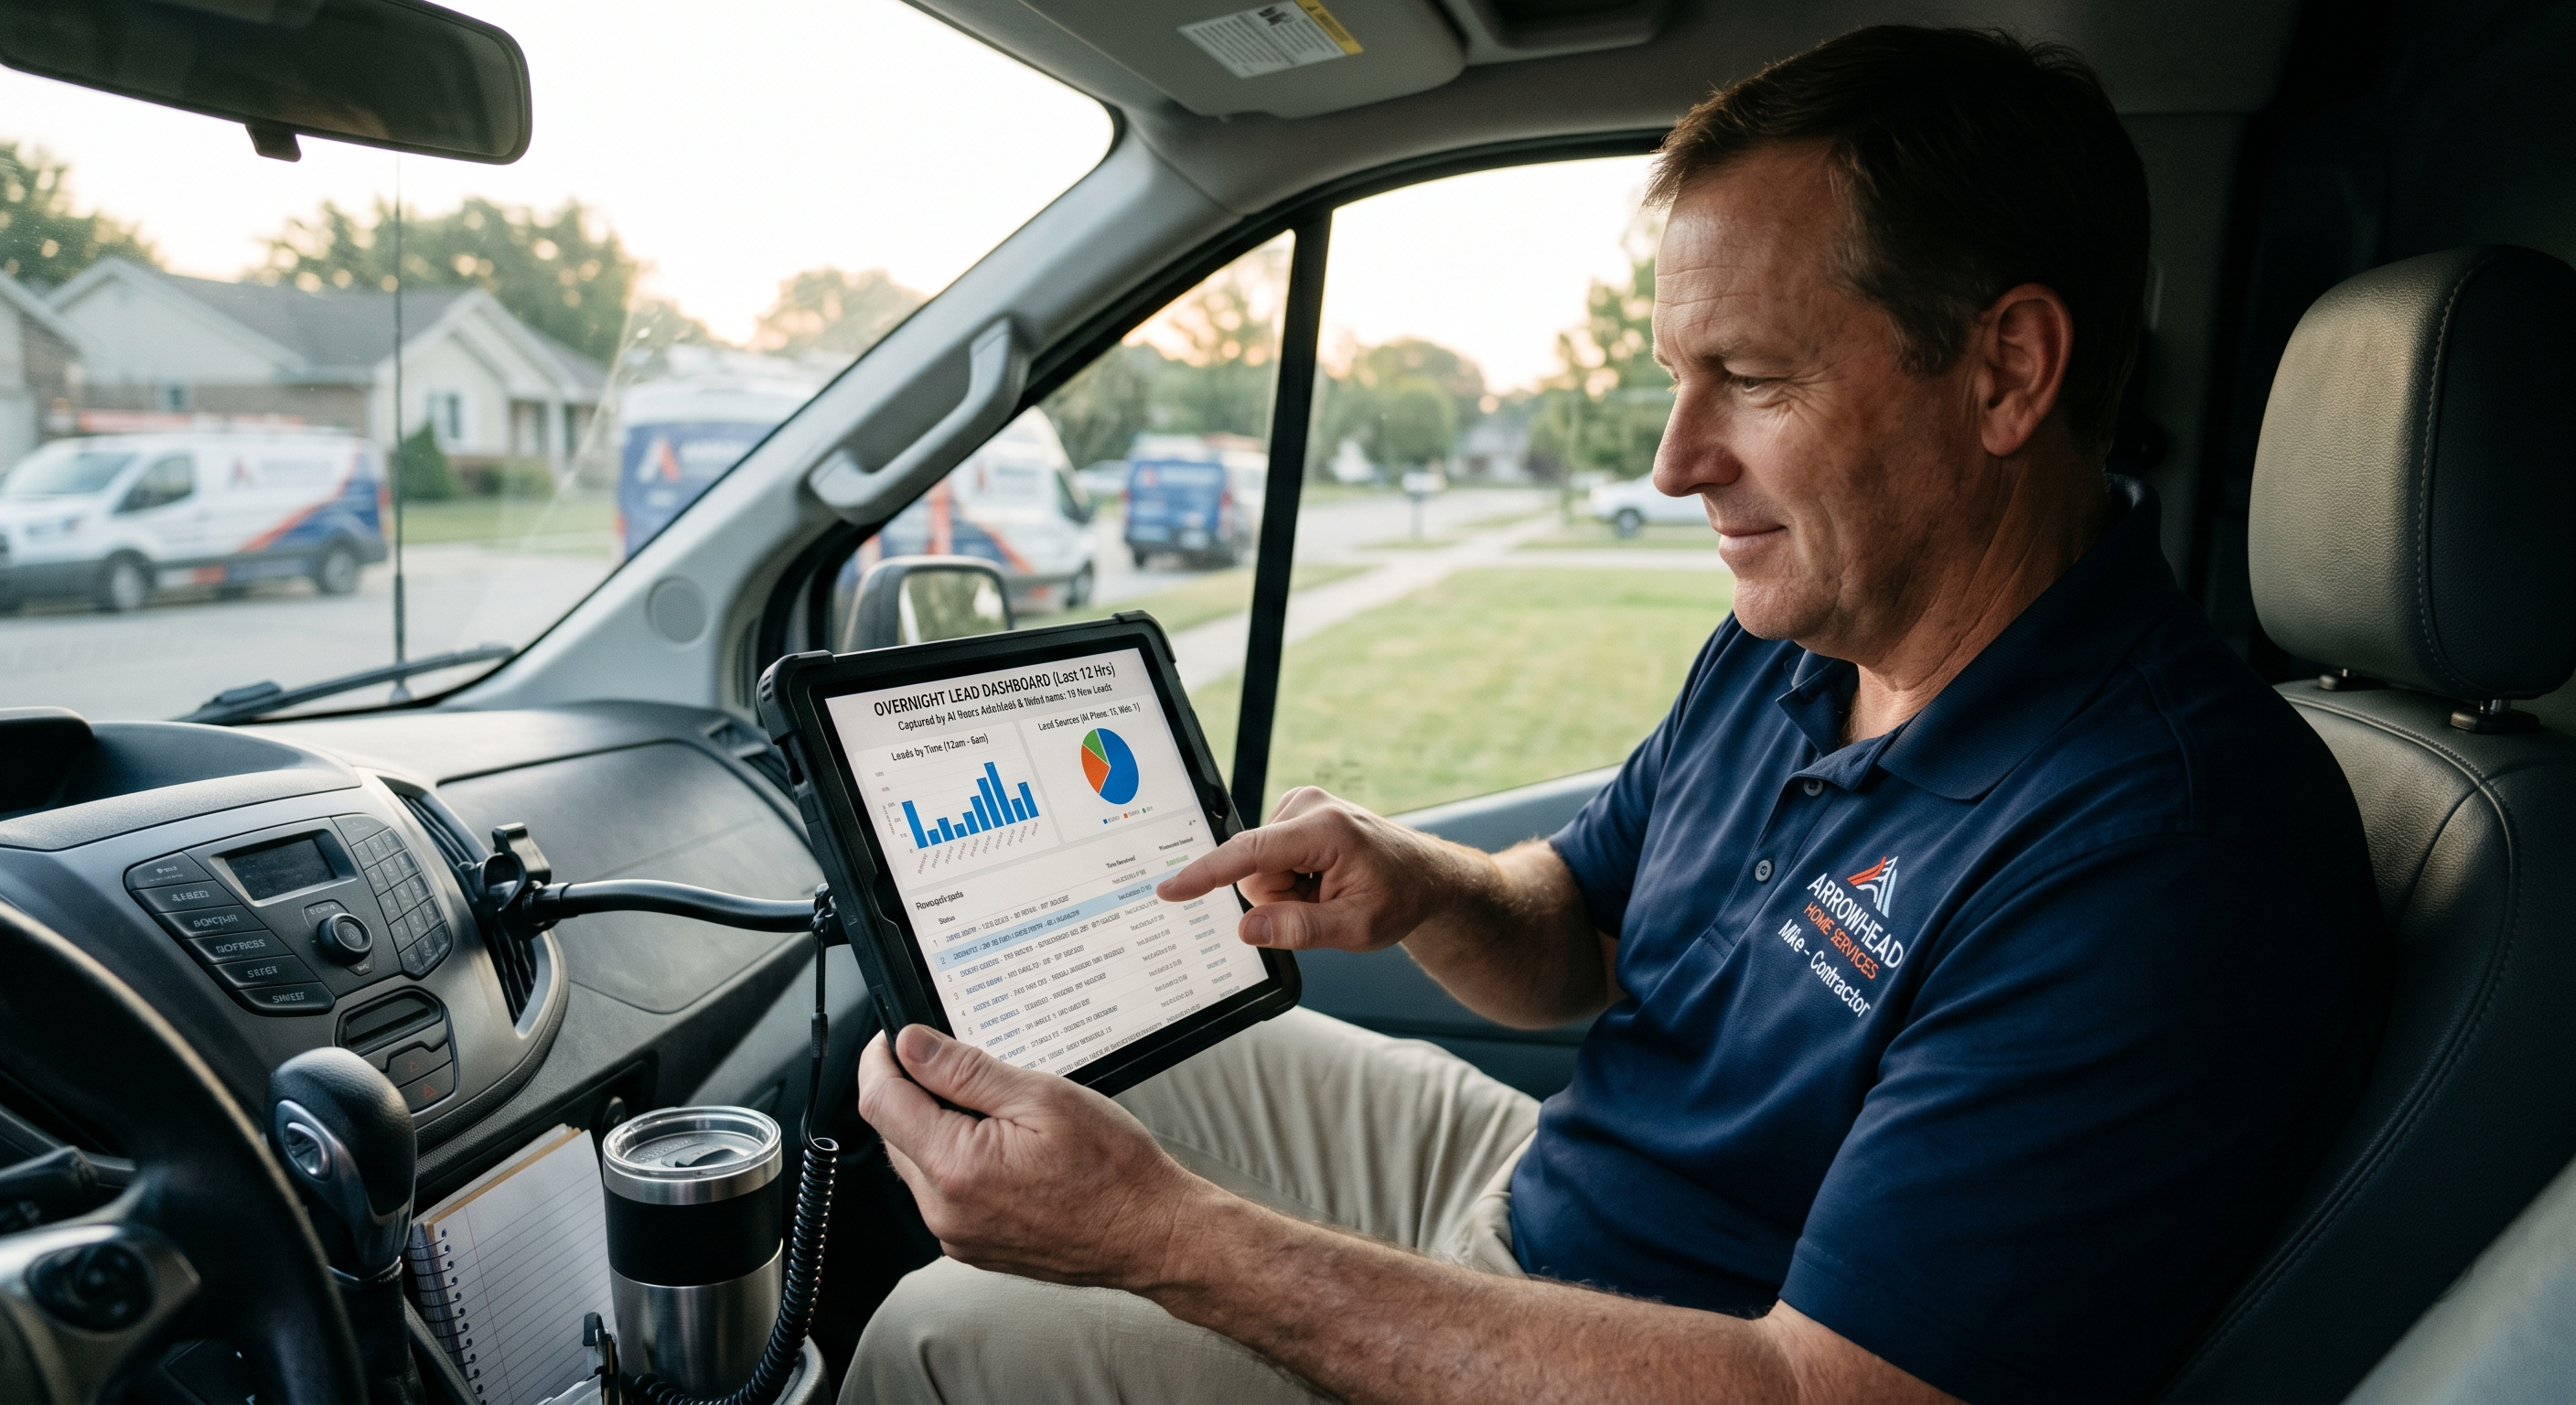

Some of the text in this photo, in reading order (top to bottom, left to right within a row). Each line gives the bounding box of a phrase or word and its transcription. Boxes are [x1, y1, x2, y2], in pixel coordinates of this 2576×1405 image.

[874, 661, 1117, 717] OVERNIGHT LEAD DASHBOARD (Last 12 Hrs)
[897, 712, 936, 732] Captured
[935, 712, 946, 726] by
[1017, 696, 1025, 709] &
[1076, 686, 1093, 699] New
[1092, 682, 1113, 696] Leads
[913, 745, 925, 758] by
[943, 739, 966, 754] (12am
[970, 733, 990, 745] 6am)
[1803, 901, 1880, 980] HOME SERVICES
[1806, 872, 1905, 969] ARROWHEAD
[940, 957, 947, 965] 2
[1809, 949, 1871, 1017] Contractor
